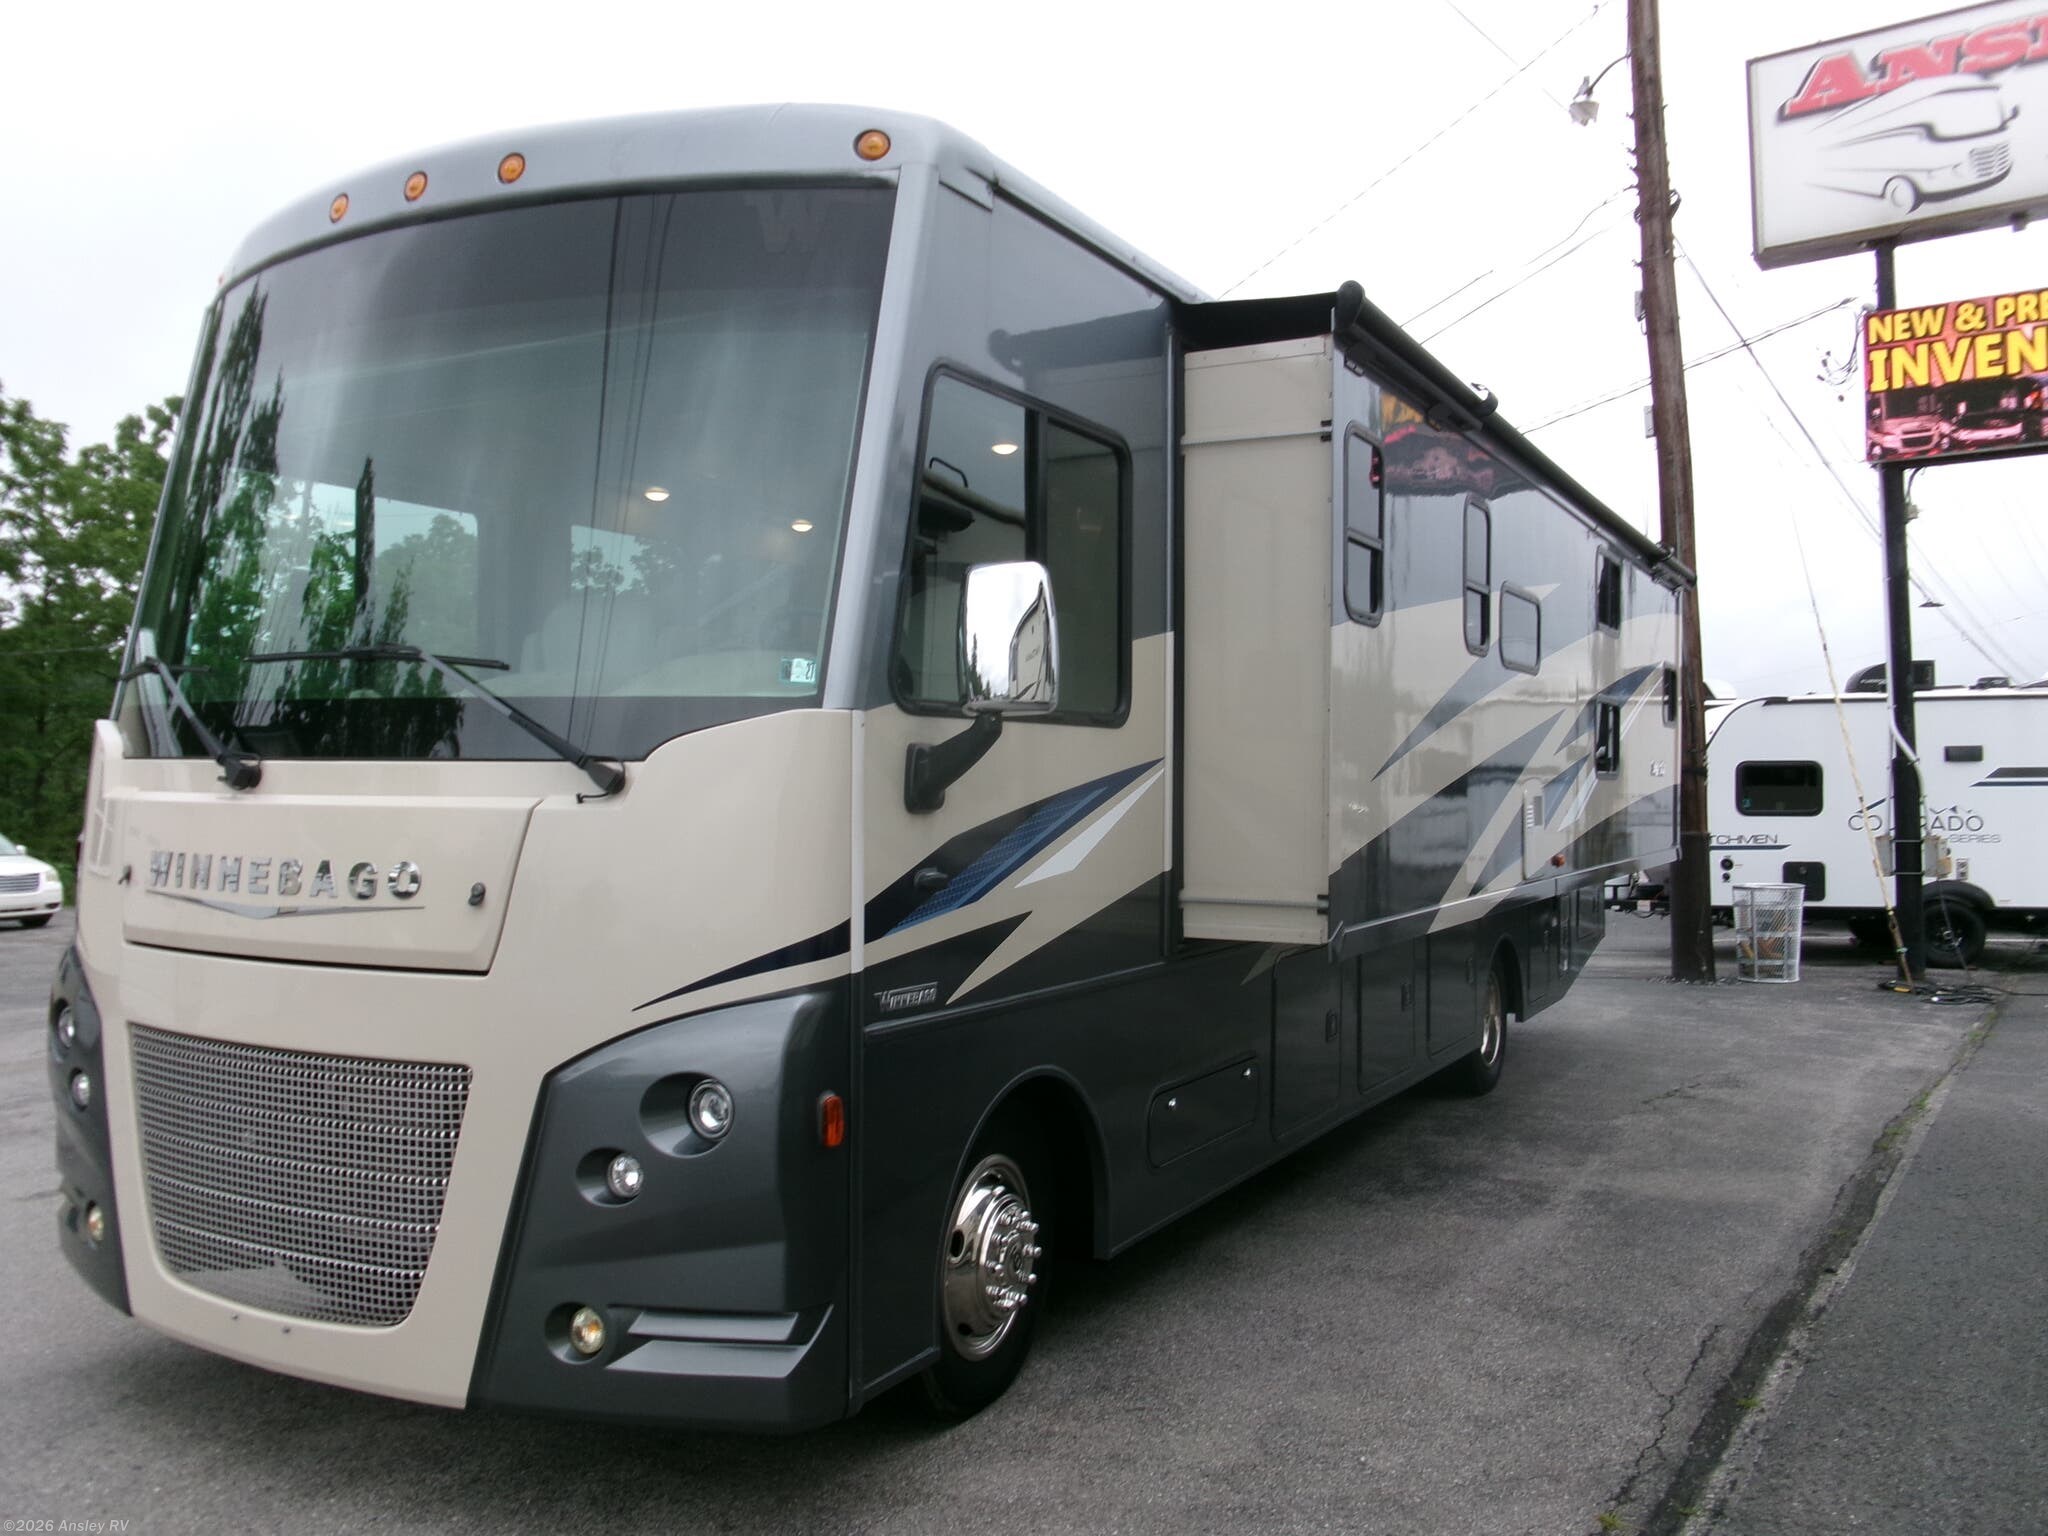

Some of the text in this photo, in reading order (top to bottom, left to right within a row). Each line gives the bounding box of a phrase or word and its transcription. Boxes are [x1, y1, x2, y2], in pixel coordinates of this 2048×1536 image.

[1867, 306, 1946, 345] NEW
[1954, 302, 1988, 332] &
[1868, 325, 2048, 393] INVEN
[1848, 814, 1985, 832] COADO
[150, 851, 422, 901] WINNEBAGO
